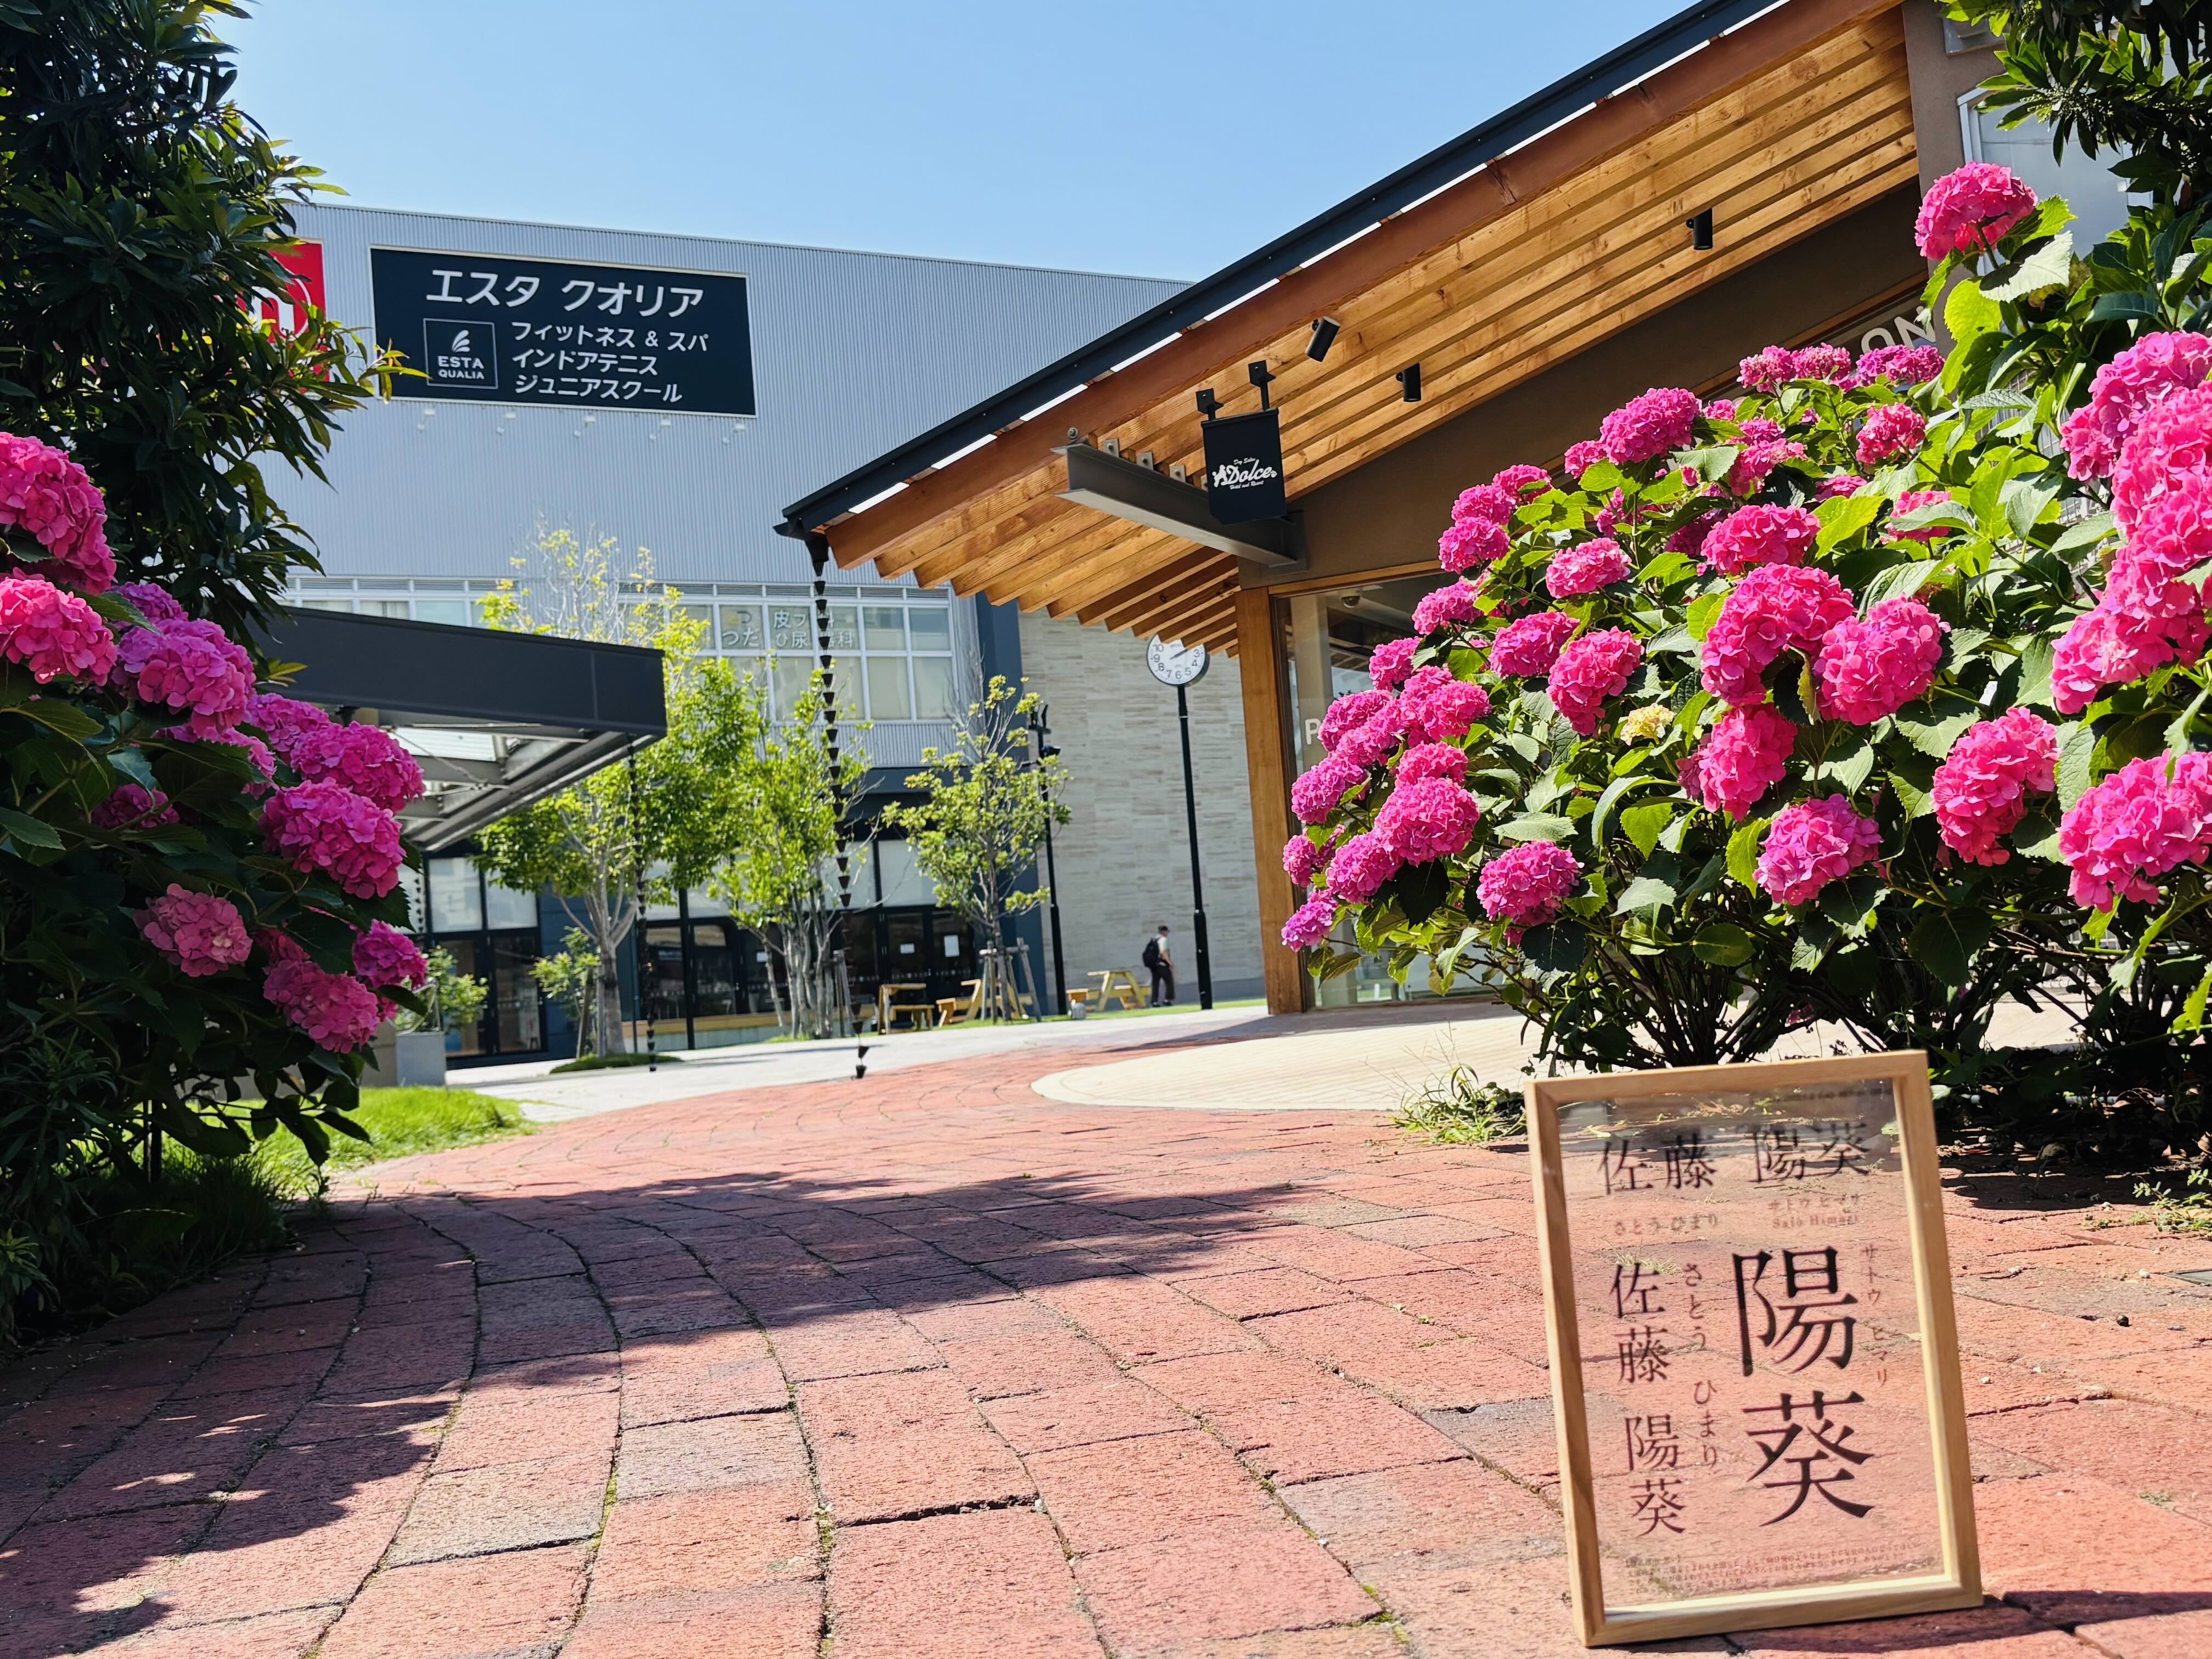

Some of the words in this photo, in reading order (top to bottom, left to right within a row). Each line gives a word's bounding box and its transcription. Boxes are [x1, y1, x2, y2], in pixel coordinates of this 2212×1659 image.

[426, 269, 540, 307] エスタ
[561, 280, 704, 318] クオリア
[511, 322, 636, 348] フィットネス
[644, 330, 659, 347] &
[667, 331, 709, 351] スパ
[437, 355, 485, 369] ESTA
[512, 348, 658, 376] インドアテニス
[438, 369, 485, 380] QUALIA
[515, 374, 683, 403] ジュニアスクール
[1220, 459, 1272, 486] Dolce
[1154, 654, 1160, 662] 9
[1194, 649, 1200, 657] 3
[1158, 662, 1164, 671] 8
[1185, 667, 1191, 676] 5
[1166, 670, 1172, 678] 7
[1175, 671, 1182, 679] 6
[1732, 1245, 1876, 1527] 陽葵
